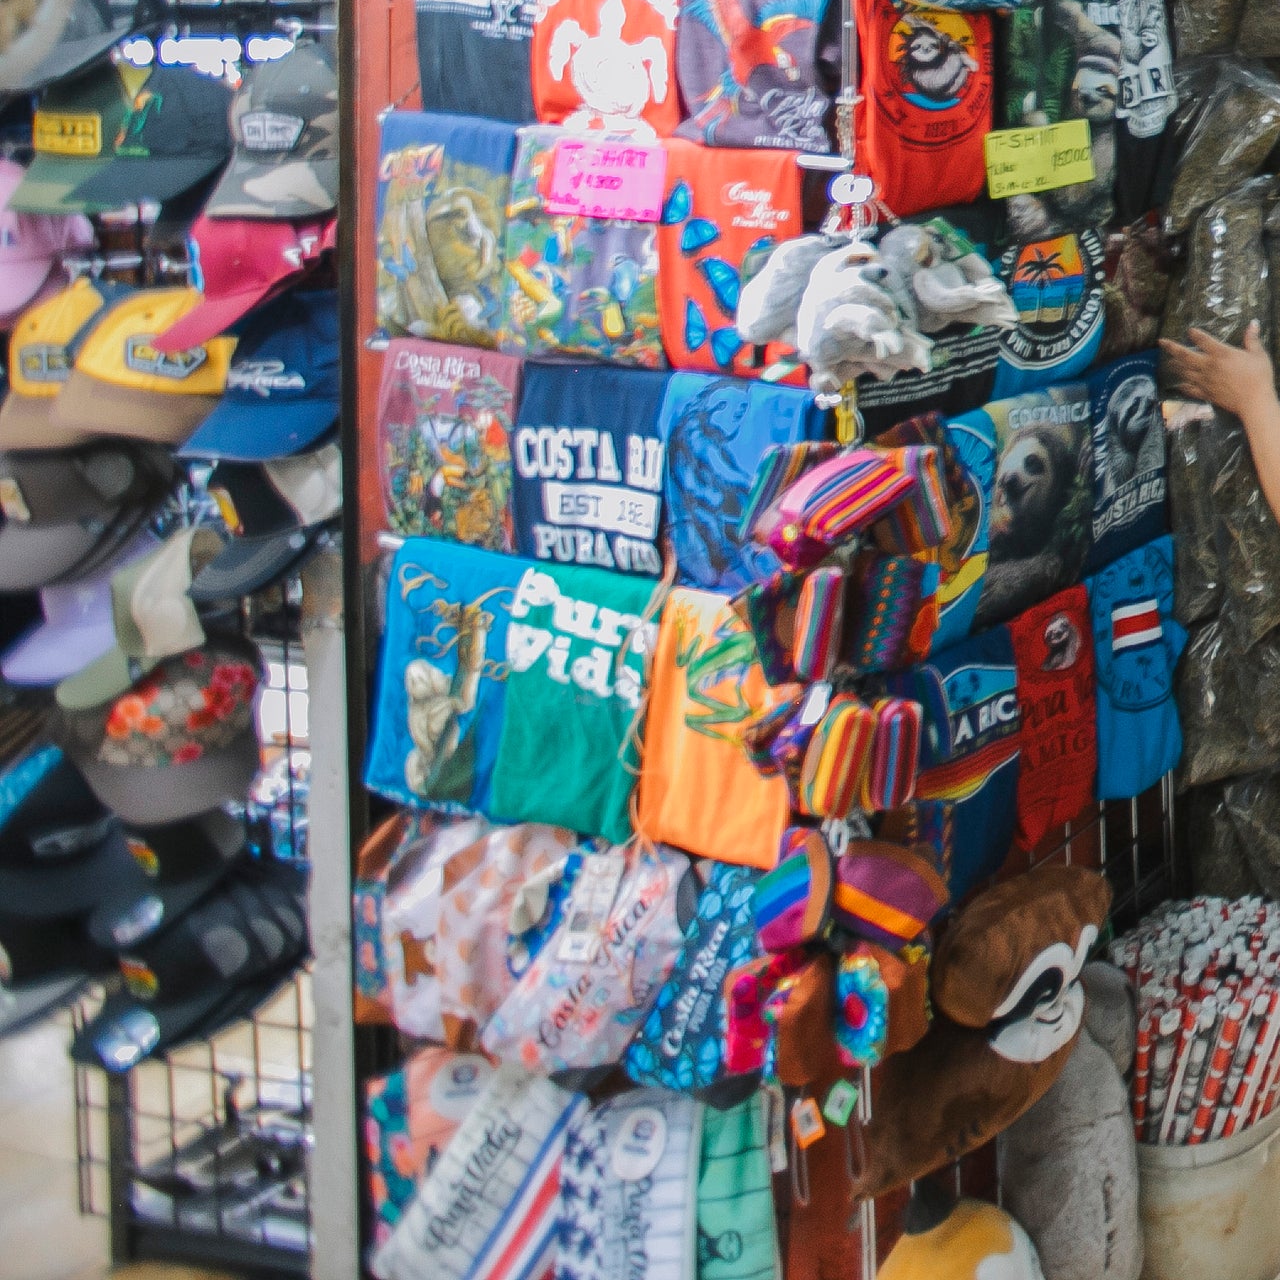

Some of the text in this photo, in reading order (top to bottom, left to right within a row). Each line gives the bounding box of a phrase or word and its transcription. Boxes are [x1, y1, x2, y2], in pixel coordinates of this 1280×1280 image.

[443, 355, 481, 379] Rica
[516, 426, 622, 482] COSTA
[559, 493, 603, 518] EST
[533, 522, 615, 568] PURA
[511, 567, 660, 654] Pura
